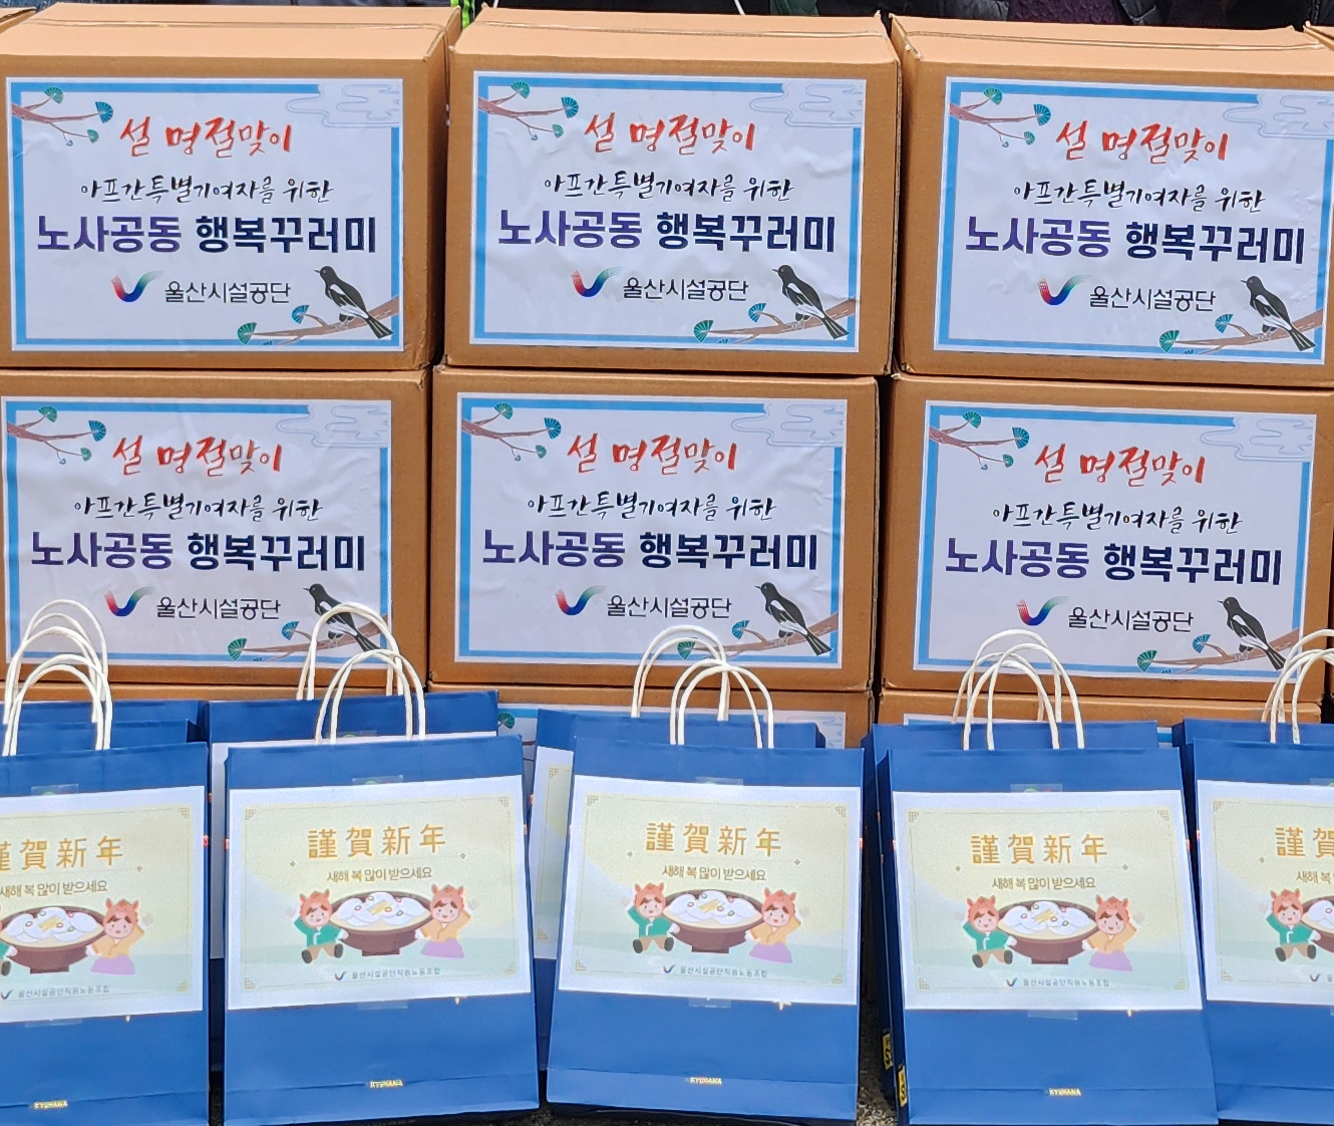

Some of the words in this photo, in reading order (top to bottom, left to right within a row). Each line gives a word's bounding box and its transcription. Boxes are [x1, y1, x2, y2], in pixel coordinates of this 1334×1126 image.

[119, 116, 151, 158] 설
[167, 116, 291, 158] 명절맞이
[584, 112, 616, 153] 설
[630, 114, 755, 155] 명절맞이
[1055, 120, 1089, 161] 설
[1102, 123, 1229, 165] 명절맞이
[81, 175, 275, 203] 아프간특별기여자를
[282, 178, 334, 202] 위한
[544, 170, 736, 202] 아프간특별기여자를
[744, 177, 794, 202] 위한
[1014, 178, 1208, 212] 아프간특별기여자를
[1214, 187, 1266, 212] 위한
[37, 215, 182, 253] 노사공동
[196, 215, 376, 253] 행복꾸러미
[498, 209, 642, 249] 노사공동
[657, 212, 835, 252] 행복꾸러미
[965, 216, 1111, 258] 노사공동
[1125, 221, 1304, 265] 행복꾸러미
[165, 281, 291, 304] 울산시설공단
[623, 277, 749, 301] 울산시설공단
[1090, 286, 1215, 312] 울산시설공단
[112, 434, 143, 477] 설
[157, 436, 282, 477] 명절맞이
[567, 433, 598, 474] 설
[613, 434, 737, 475] 명절맞이
[1034, 443, 1066, 485] 설
[1080, 445, 1205, 488] 명절맞이
[74, 493, 265, 521] 아프간특별기여자를
[272, 497, 323, 521] 위한
[527, 491, 719, 522] 아프간특별기여자를
[725, 496, 777, 522] 위한
[992, 501, 1184, 535] 아프간특별기여자를
[1192, 508, 1243, 535] 위한
[31, 532, 173, 568] 노사공동
[187, 532, 364, 572] 행복꾸러미
[483, 529, 625, 568] 노사공동
[639, 532, 818, 571] 행복꾸러미
[945, 538, 1089, 580] 노사공동
[1104, 543, 1282, 586] 행복꾸러미
[156, 597, 281, 620] 울산시설공단
[607, 594, 732, 619] 울산시설공단
[1068, 607, 1194, 633] 울산시설공단
[308, 823, 446, 859] 謹賀新年
[646, 822, 782, 857] 謹賀新年
[971, 833, 1108, 864] 謹賀新年
[0, 885, 22, 898] 새해
[25, 884, 35, 897] 복
[37, 882, 60, 896] 많이
[63, 880, 108, 895] 받으세요
[328, 871, 349, 883] 새해
[352, 869, 363, 882] 복
[365, 868, 387, 882] 많이
[389, 867, 432, 881] 받으세요
[663, 865, 684, 878] 새해
[687, 866, 697, 879] 복
[699, 867, 720, 880] 많이
[723, 868, 767, 882] 받으세요
[992, 877, 1013, 890] 새해
[1016, 878, 1026, 890] 복
[1028, 877, 1050, 890] 많이
[1053, 876, 1096, 889] 받으세요
[1297, 871, 1318, 884] 새해
[1321, 872, 1331, 885] 복
